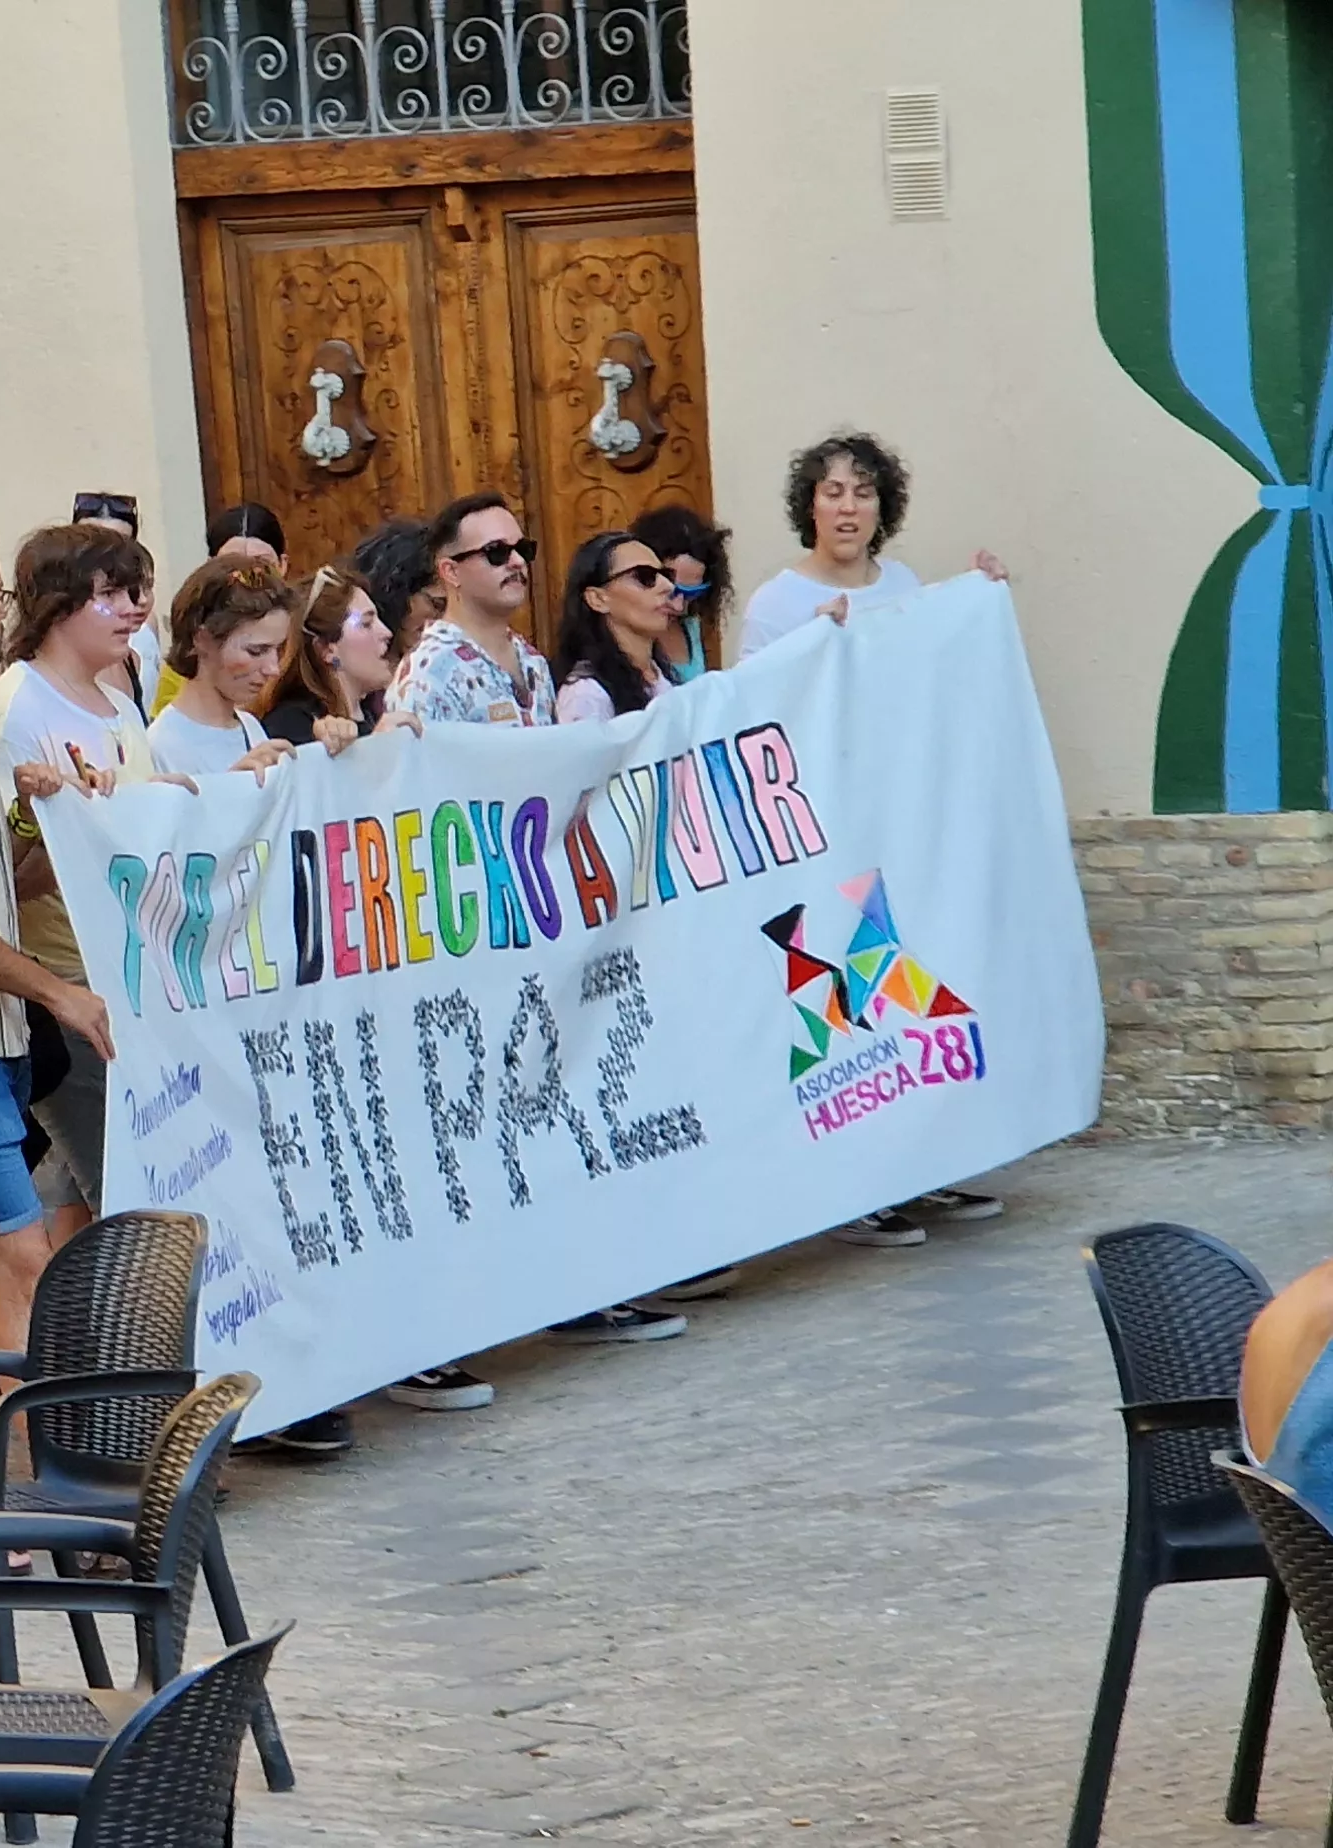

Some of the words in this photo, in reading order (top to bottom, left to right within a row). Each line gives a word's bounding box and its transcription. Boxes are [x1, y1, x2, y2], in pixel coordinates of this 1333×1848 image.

[108, 851, 217, 1018] POR
[218, 838, 279, 1002] EL
[290, 796, 563, 988] DERECHO
[563, 787, 618, 931] A
[607, 721, 829, 913] VIVIR
[239, 1006, 415, 1274] EN
[413, 946, 709, 1225] PAZ
[795, 1034, 902, 1107] ASOCIACIÓN
